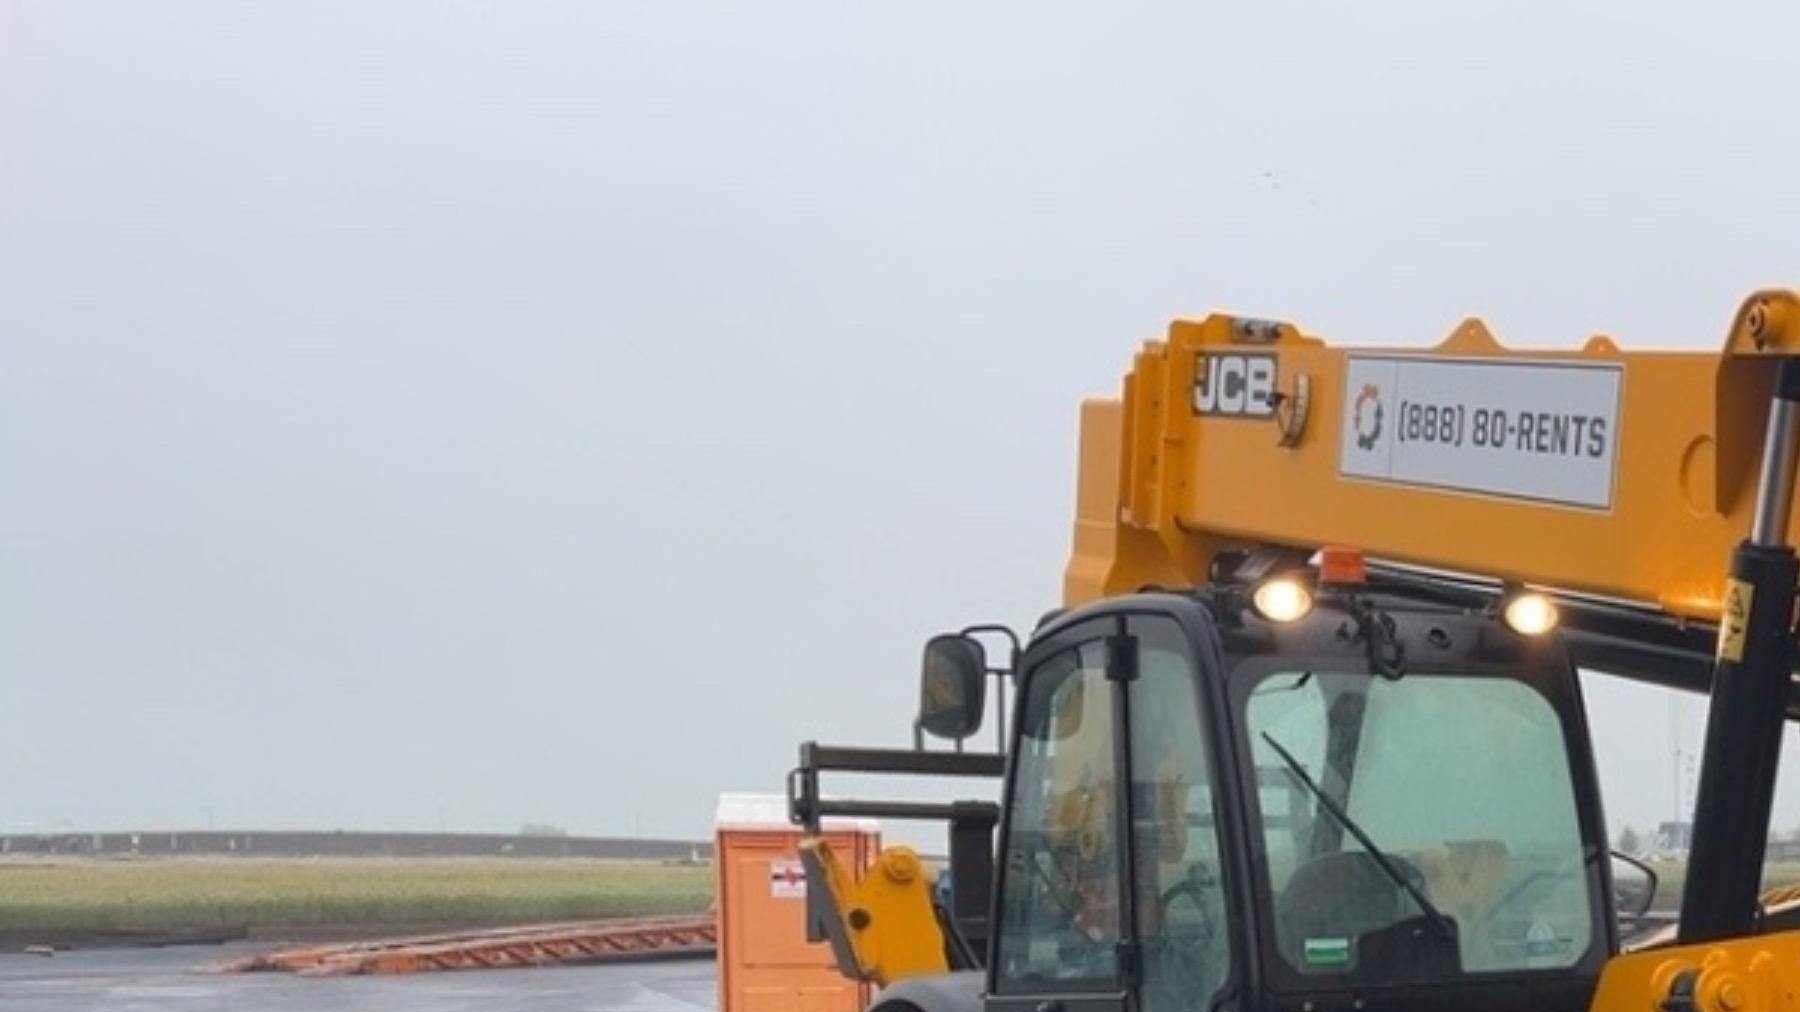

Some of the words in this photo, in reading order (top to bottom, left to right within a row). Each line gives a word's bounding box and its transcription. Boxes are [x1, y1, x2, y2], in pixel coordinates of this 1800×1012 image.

[1193, 355, 1276, 416] JCB
[1398, 400, 1465, 447] (888)
[1472, 408, 1607, 458] 80-RENTS
